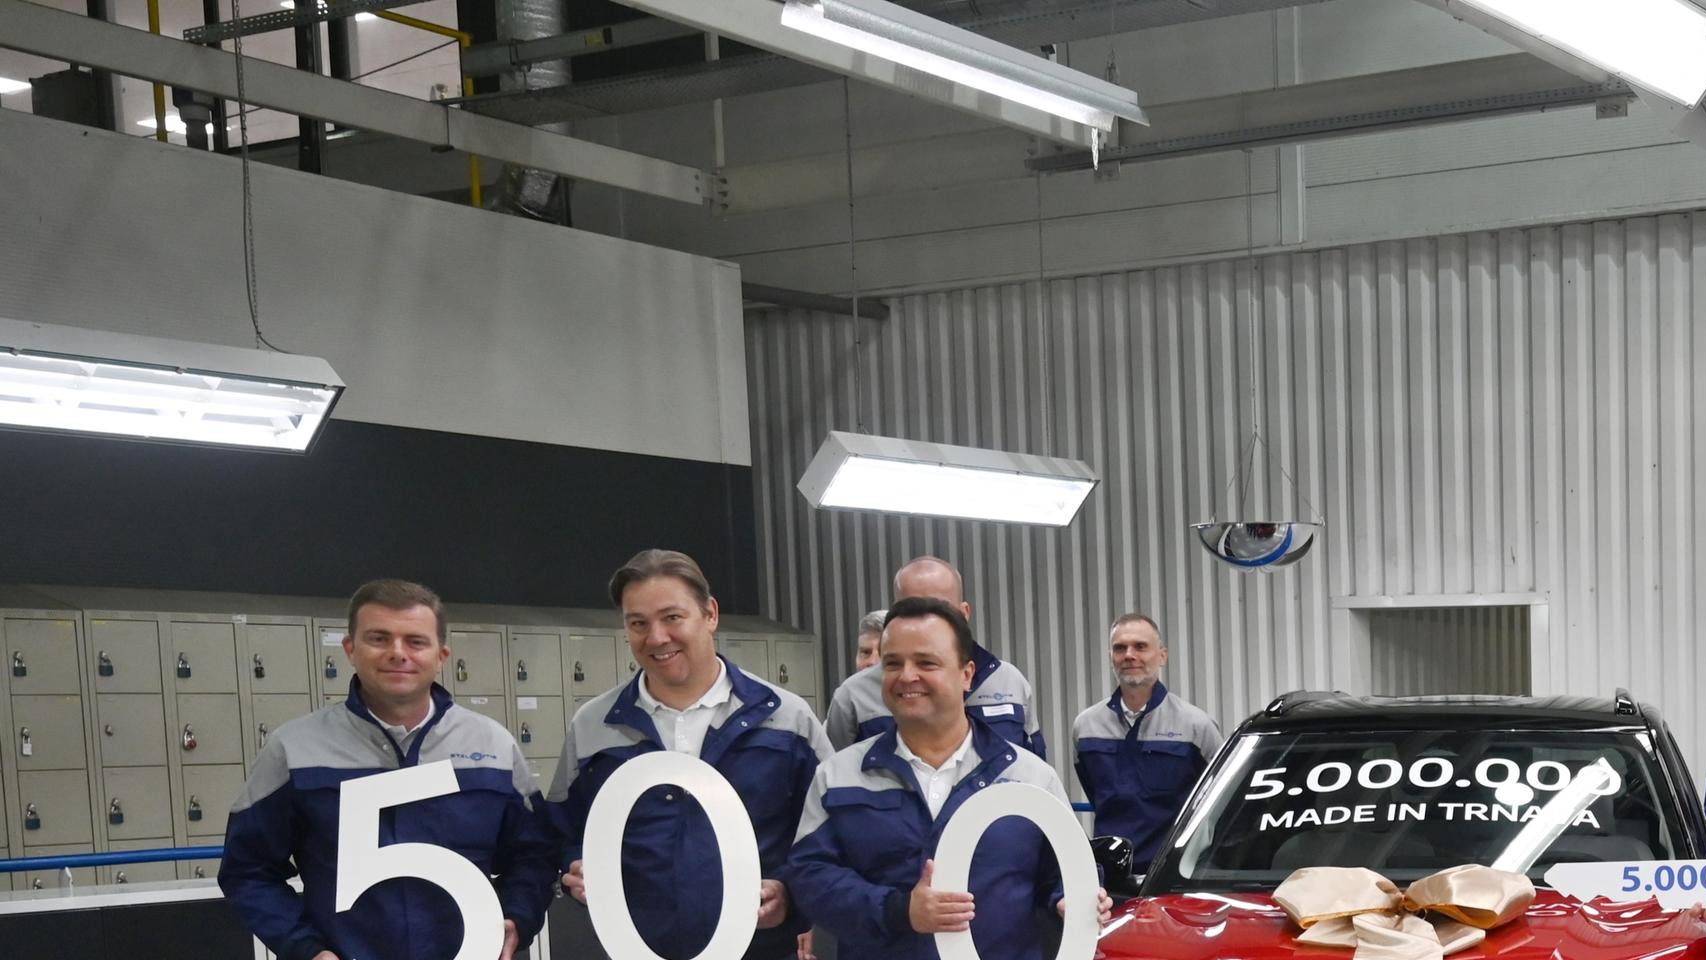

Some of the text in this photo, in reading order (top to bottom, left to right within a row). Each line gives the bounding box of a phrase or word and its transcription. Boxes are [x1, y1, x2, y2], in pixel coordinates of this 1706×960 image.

[1244, 757, 1622, 801] 5.000.000
[1259, 802, 1601, 831] MADE IN TRNAA
